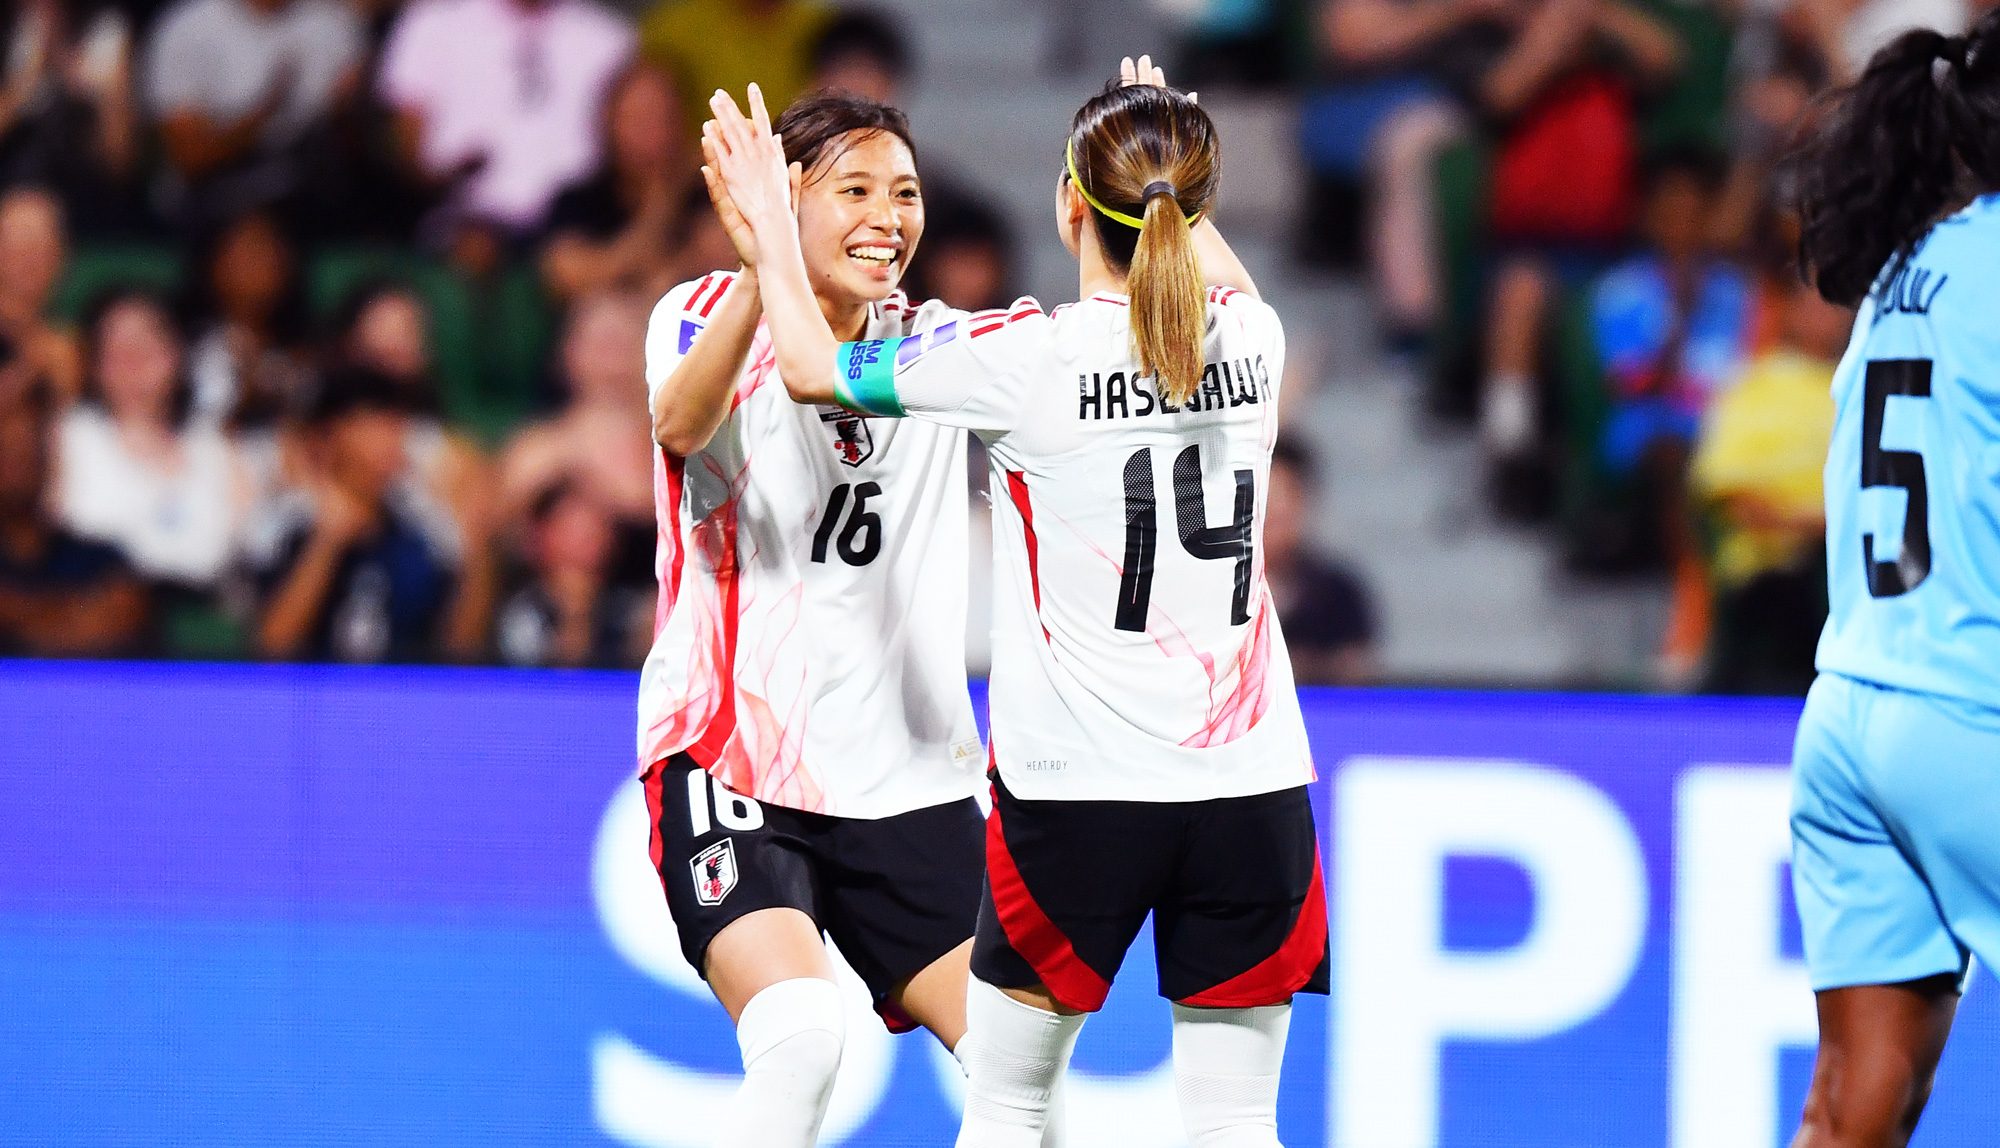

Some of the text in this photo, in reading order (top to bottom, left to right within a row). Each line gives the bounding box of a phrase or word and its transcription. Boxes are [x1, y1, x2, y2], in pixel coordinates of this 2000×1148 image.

[1079, 353, 1272, 420] HASAWA
[811, 481, 883, 567] 16
[1114, 444, 1255, 633] 14
[1860, 359, 1934, 598] 5
[687, 767, 765, 838] 16
[590, 756, 1970, 1148] SPP
